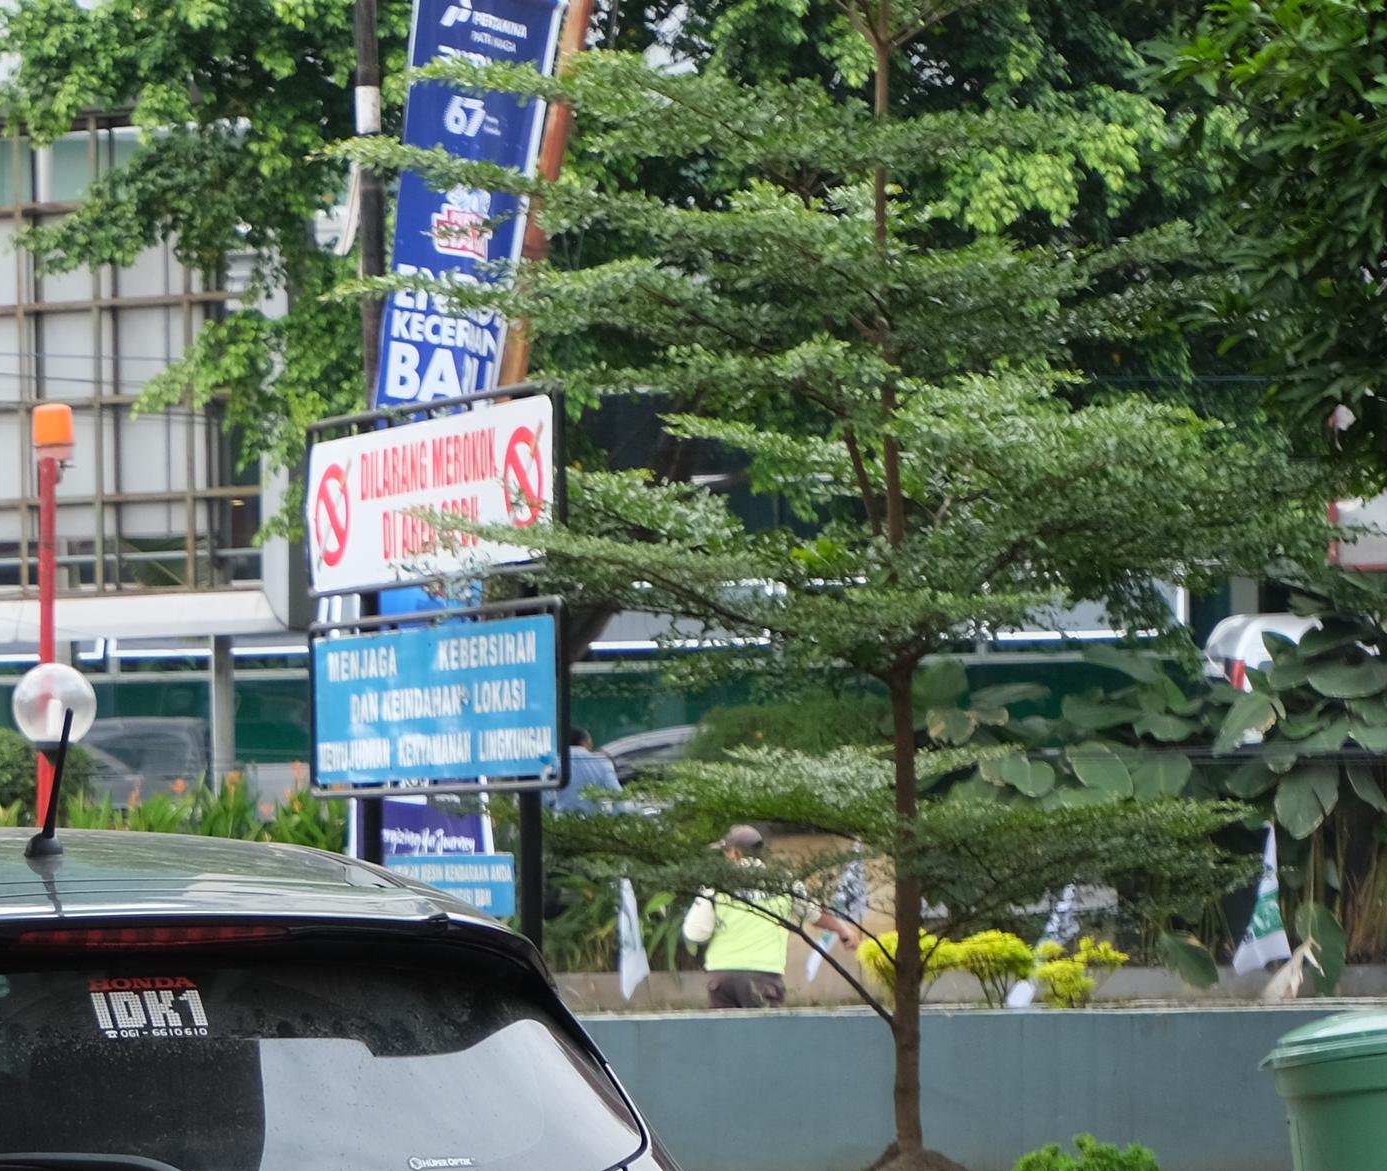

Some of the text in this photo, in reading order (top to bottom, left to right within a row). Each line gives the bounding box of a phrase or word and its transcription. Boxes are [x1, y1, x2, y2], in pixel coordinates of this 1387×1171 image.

[443, 94, 487, 138] 67
[360, 427, 499, 501] DILARANG MEROKOK
[382, 509, 400, 561] DI
[327, 630, 537, 683] MENJAGA KEBERSIHAN
[350, 677, 527, 726] DAN KEINDAHAN LOKASI
[479, 726, 553, 763] LINGKUNGAN
[89, 976, 198, 991] HONDA
